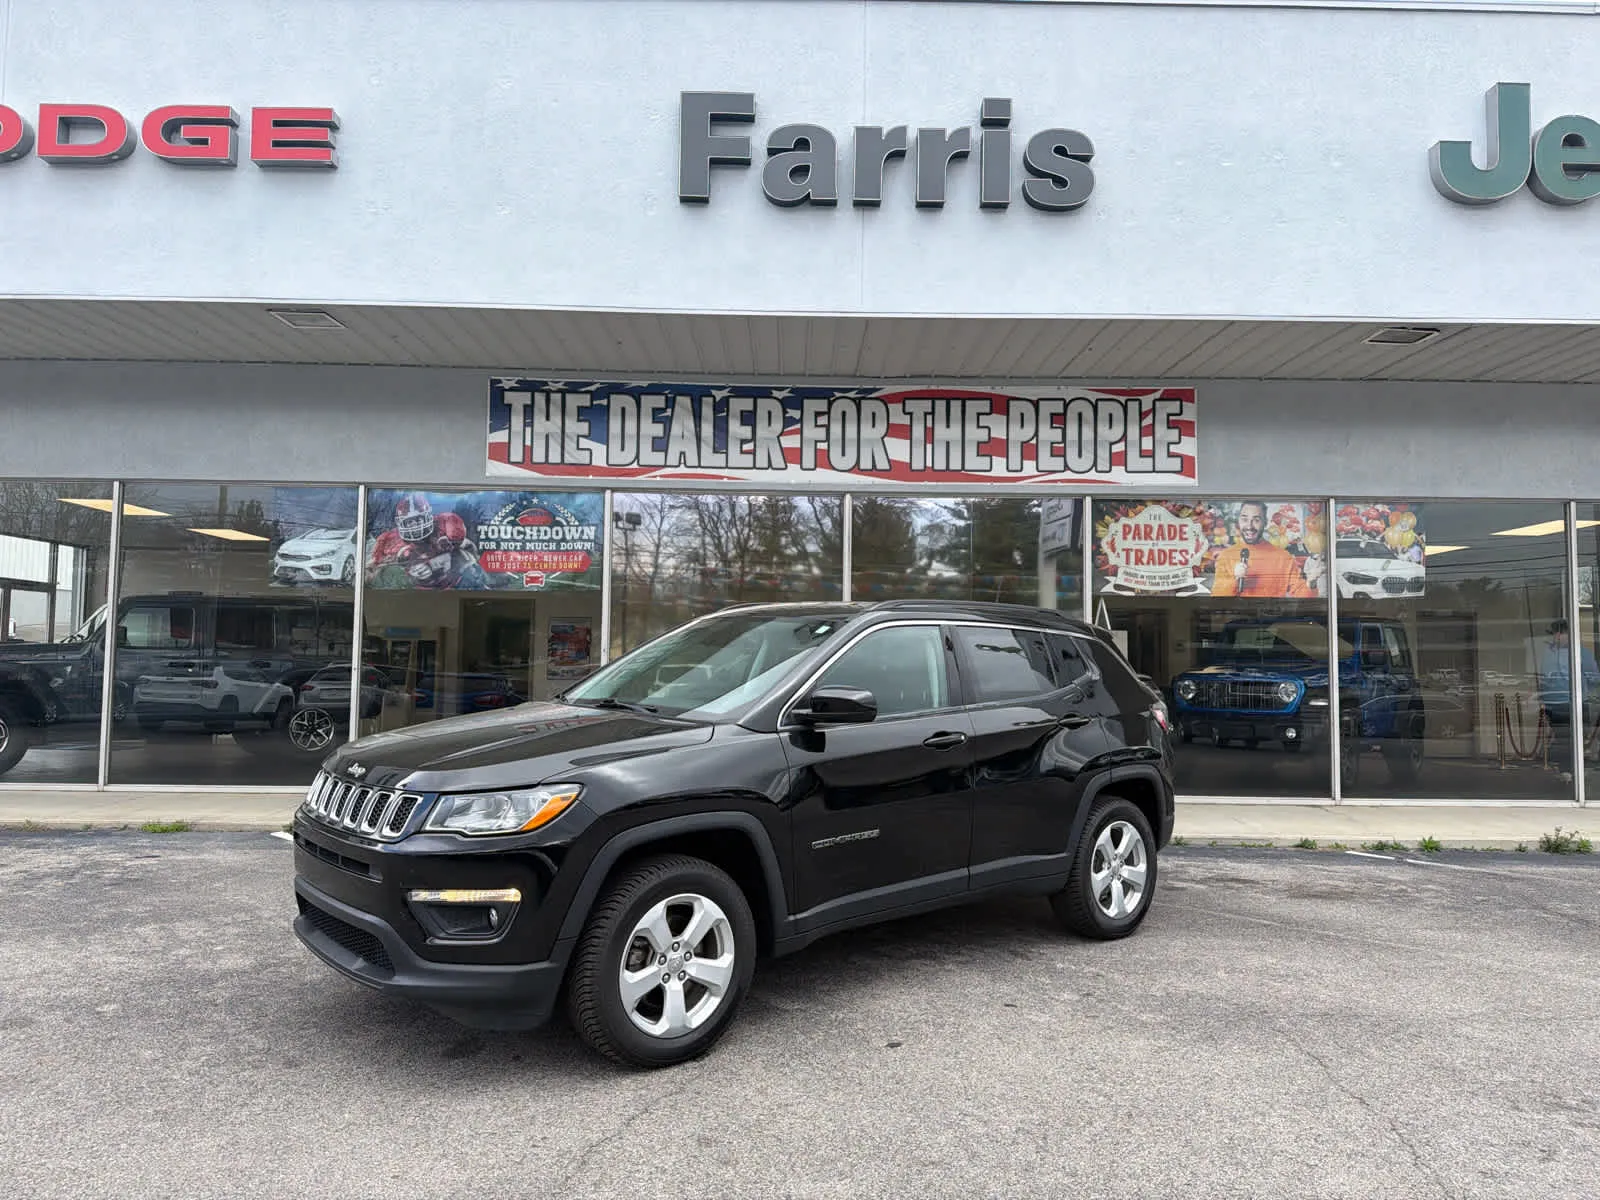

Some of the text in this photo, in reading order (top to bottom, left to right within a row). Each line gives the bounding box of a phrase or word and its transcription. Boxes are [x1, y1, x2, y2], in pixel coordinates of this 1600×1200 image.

[0, 103, 340, 169] DGE
[679, 91, 1096, 211] Farris
[502, 390, 1184, 474] THE DEALER FOR THE PEOPLE
[477, 525, 597, 540] TOUCHDOWN
[1122, 523, 1189, 541] PARADE
[479, 541, 595, 551] FOR NOT MUCH DOWN!
[487, 561, 501, 569] FOR
[504, 561, 521, 569] JUST
[1121, 548, 1190, 566] TRADES
